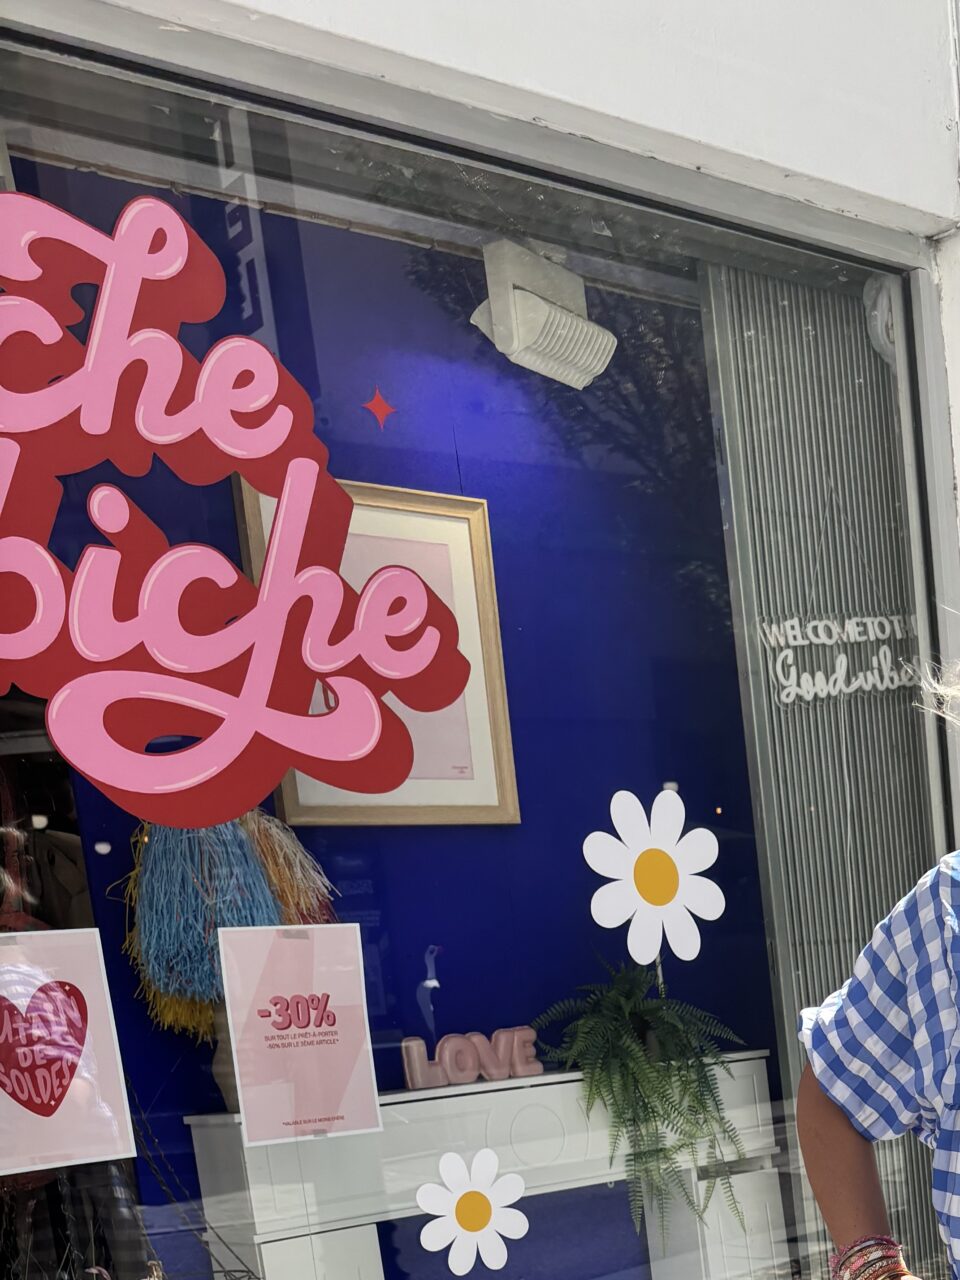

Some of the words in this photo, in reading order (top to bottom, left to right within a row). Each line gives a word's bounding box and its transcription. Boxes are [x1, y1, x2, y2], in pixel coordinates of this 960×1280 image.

[762, 616, 867, 648] WELCOME
[863, 616, 891, 641] TO
[776, 648, 850, 703] Good
[257, 993, 336, 1031] -30%
[264, 1034, 276, 1042] SUR
[401, 1025, 544, 1090] LOVE
